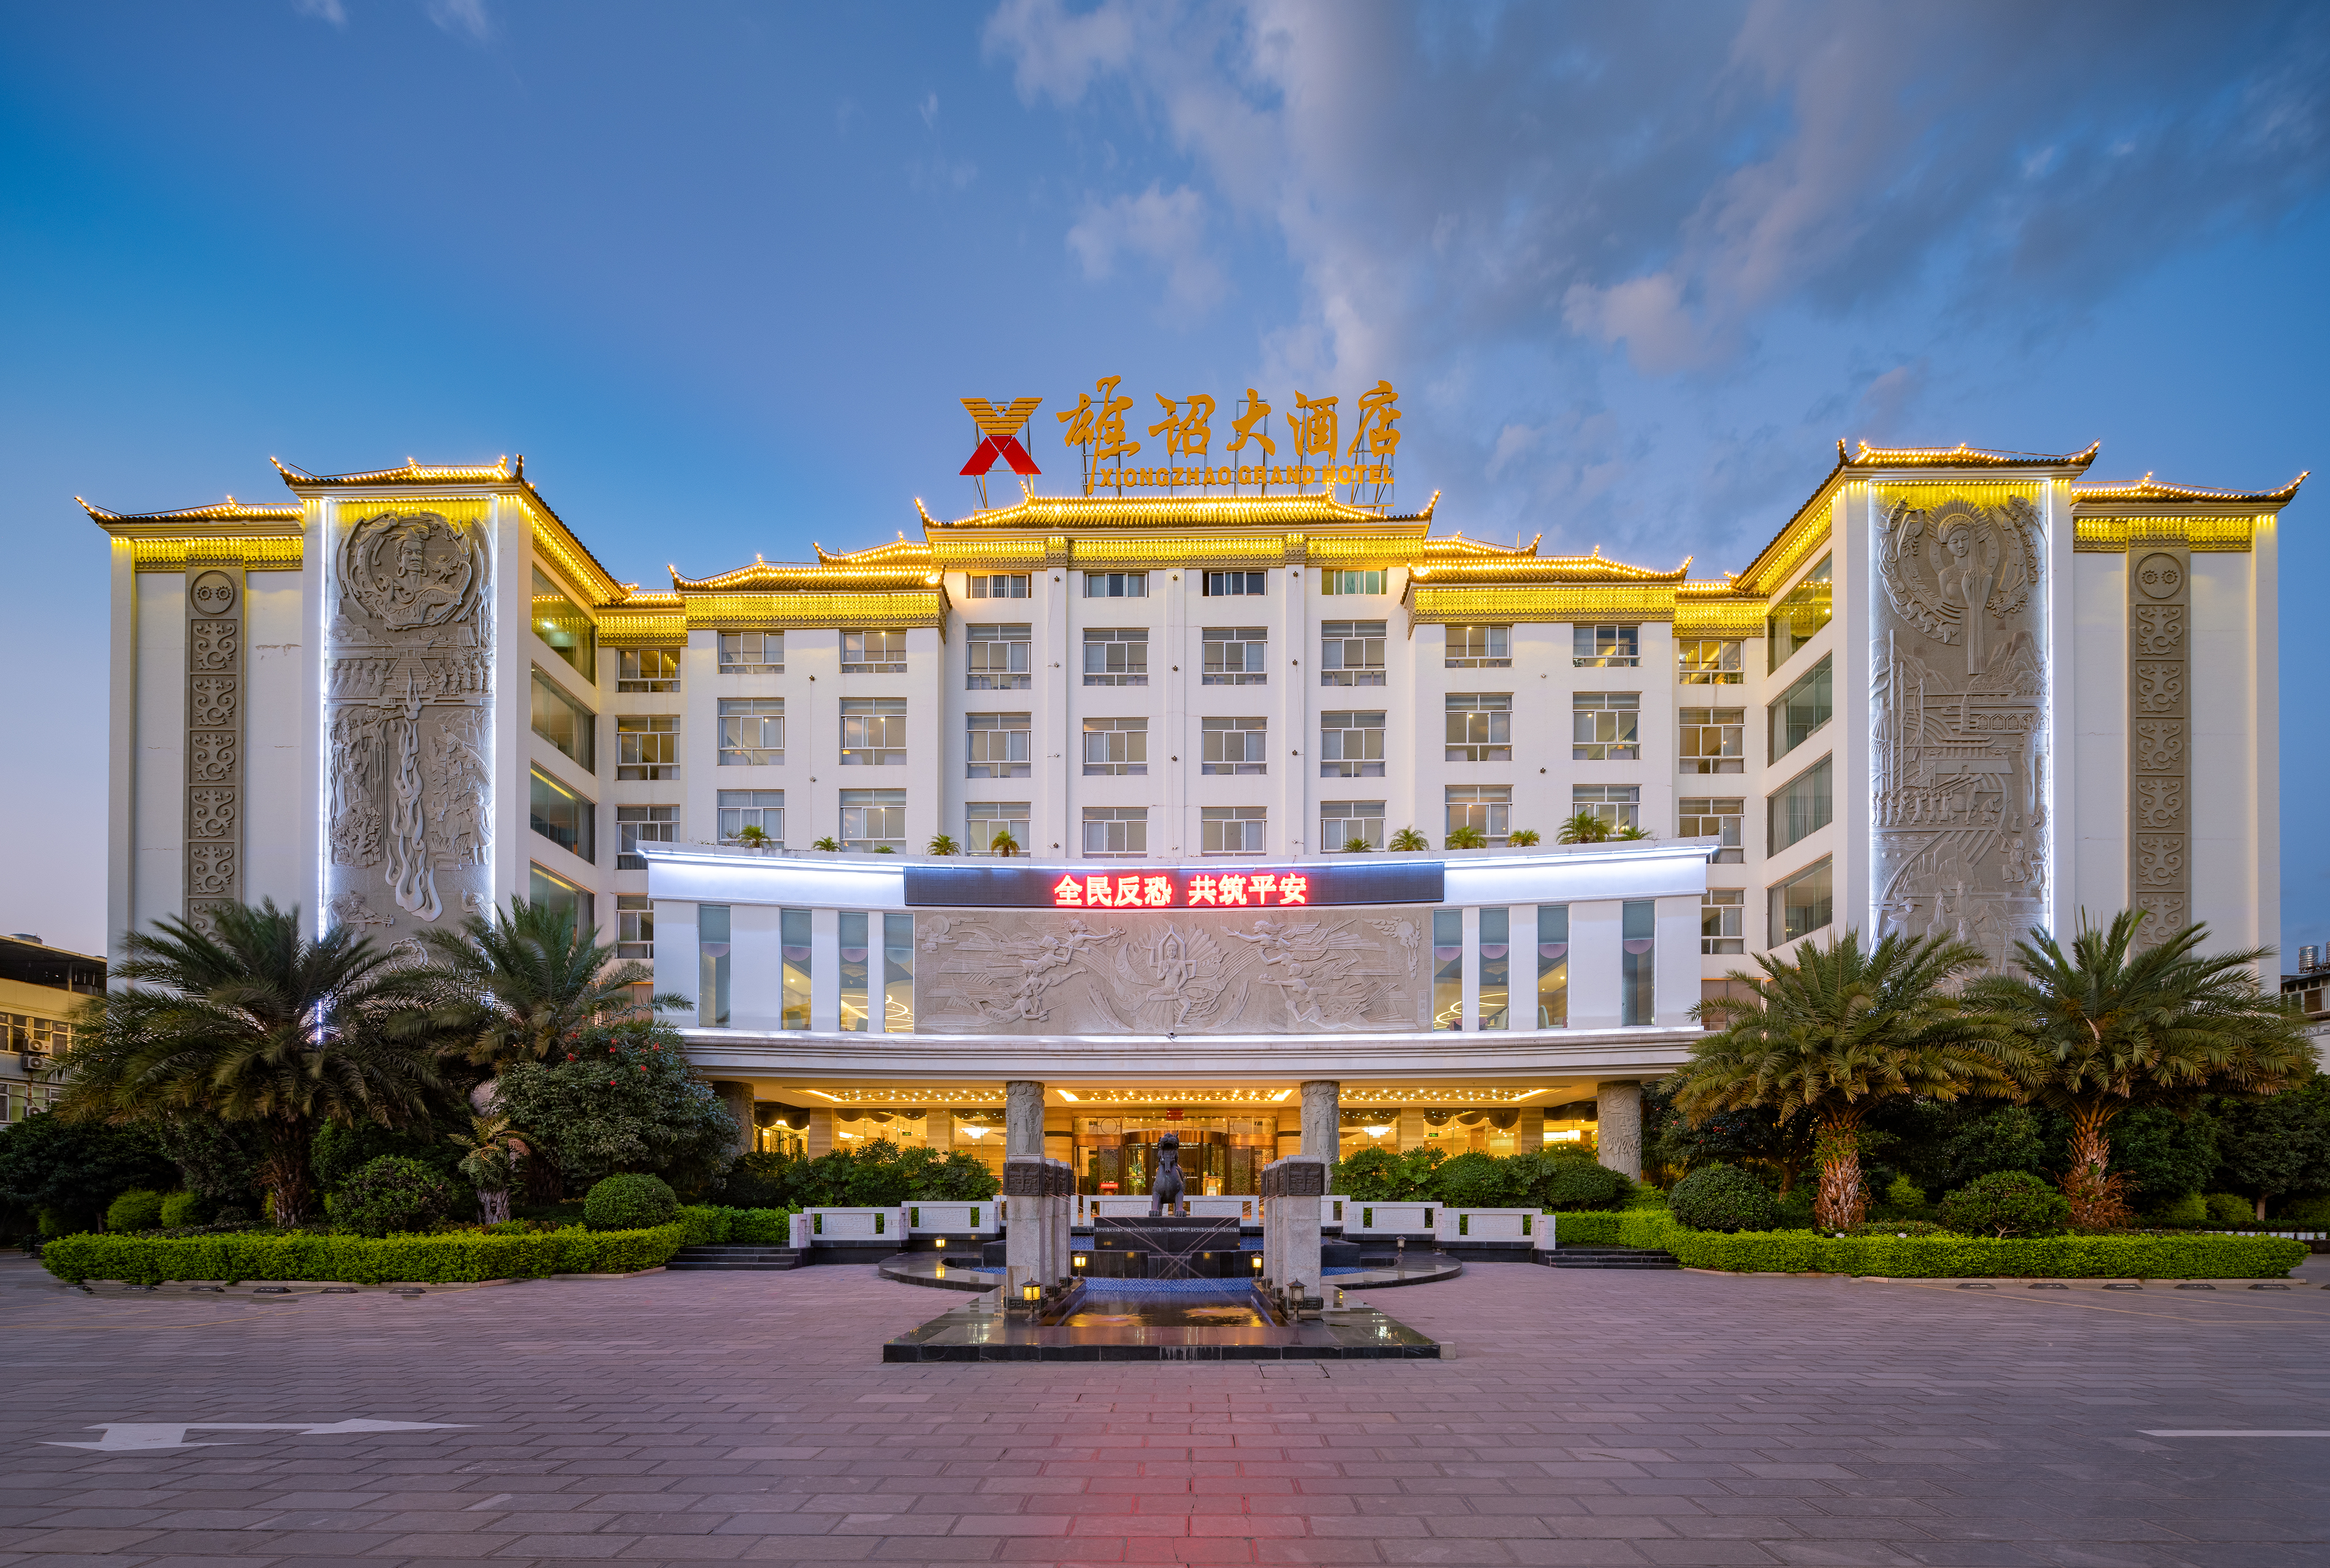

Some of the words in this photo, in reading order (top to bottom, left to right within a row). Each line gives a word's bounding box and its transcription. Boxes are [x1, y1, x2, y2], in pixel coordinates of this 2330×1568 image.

[1056, 375, 1401, 494] 雄诏大酒店
[1100, 467, 1232, 488] XIONGZHAO
[1238, 465, 1316, 485] GRAND
[1322, 465, 1394, 484] HOTEL
[1054, 875, 1172, 906] 全民反恐
[1188, 873, 1307, 905] 共筑平安
